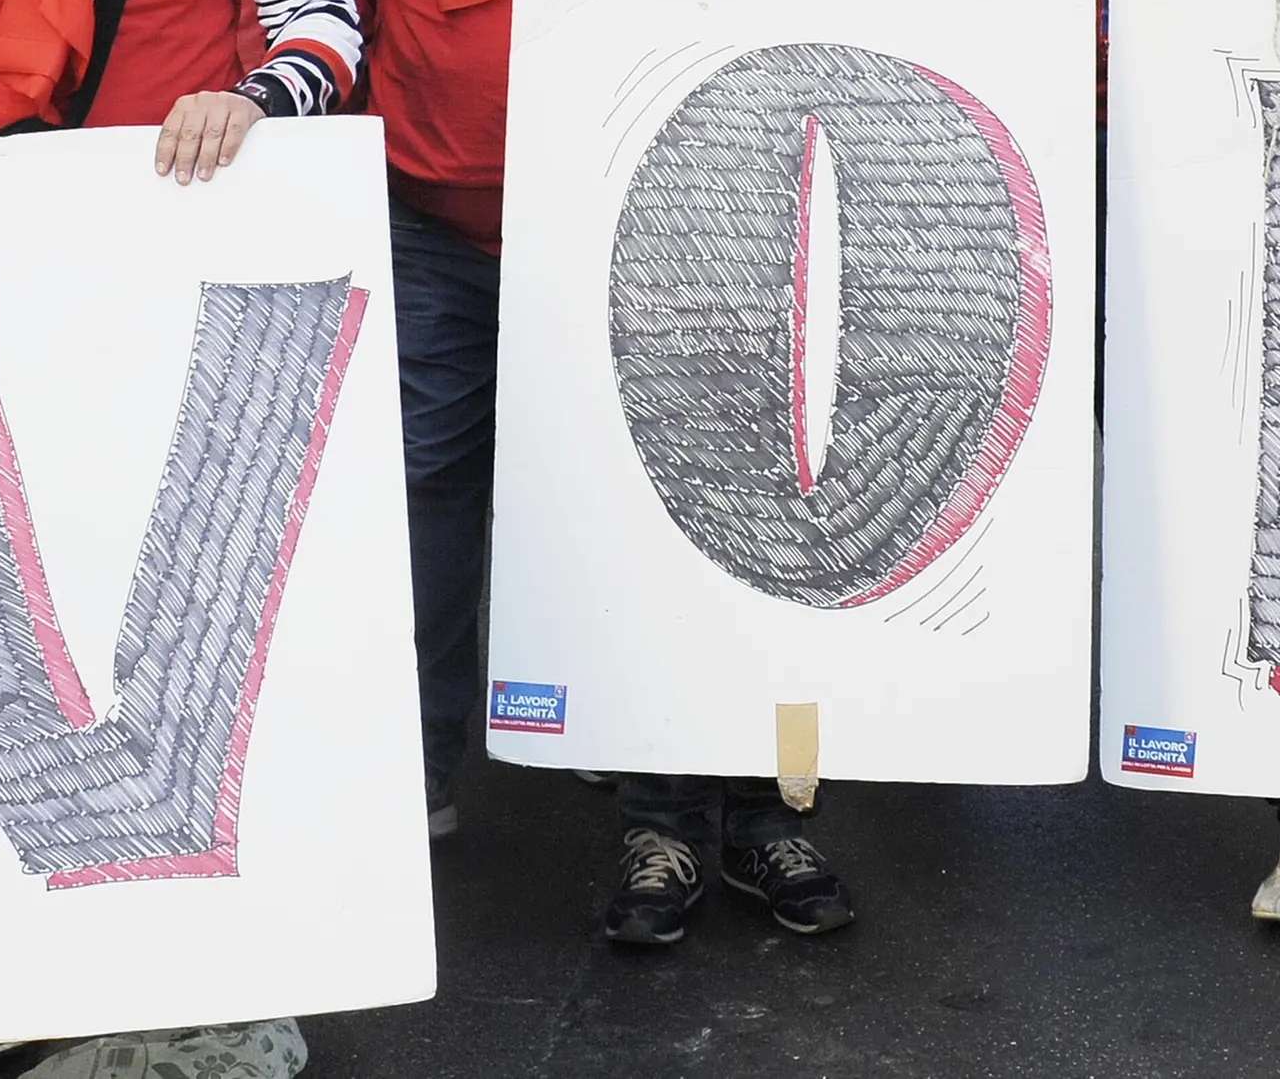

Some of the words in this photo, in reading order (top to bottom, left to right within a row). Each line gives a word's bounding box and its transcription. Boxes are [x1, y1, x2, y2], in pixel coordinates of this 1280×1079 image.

[497, 694, 508, 704] IL
[510, 695, 558, 707] LAVORO
[507, 706, 556, 719] DIGNITÀ
[1129, 738, 1139, 747] IL
[1141, 739, 1188, 752] LAVORO
[1138, 749, 1187, 764] DIGNITÀ
